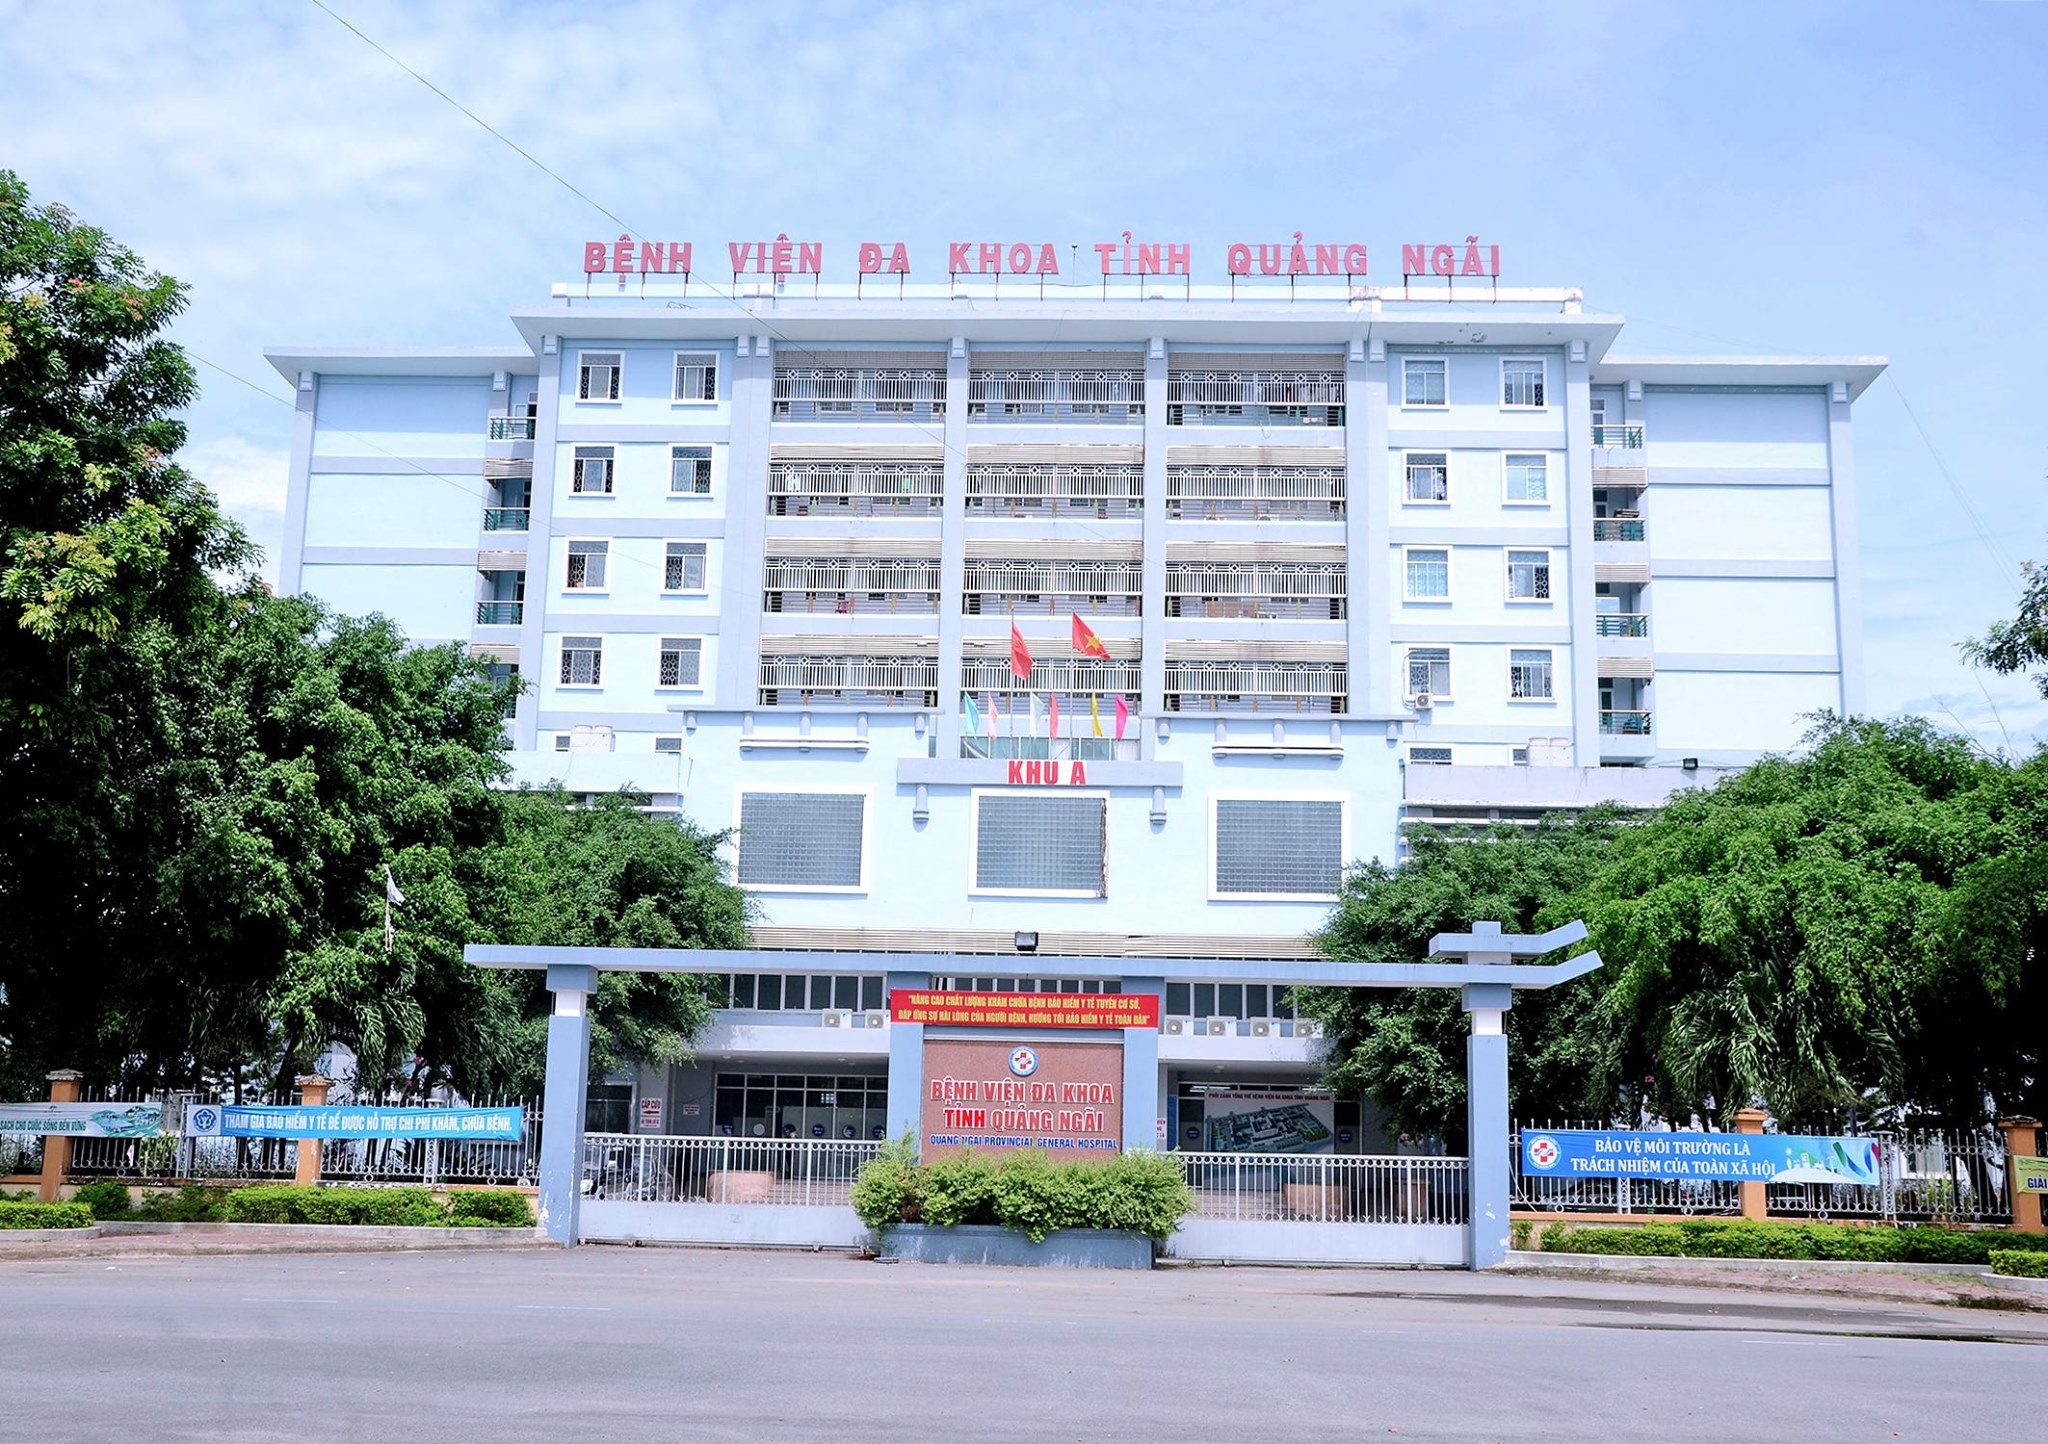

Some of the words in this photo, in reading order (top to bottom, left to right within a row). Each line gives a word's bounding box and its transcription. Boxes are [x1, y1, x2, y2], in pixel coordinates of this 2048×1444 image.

[584, 233, 692, 283] BỆNH
[729, 233, 821, 283] VIỆN
[859, 243, 911, 274] ĐA
[949, 243, 1059, 274] KHOA
[1094, 231, 1190, 274] TỈNH
[1228, 231, 1367, 276] QUẢNG
[1402, 235, 1499, 276] NGÃI
[1008, 760, 1059, 784] KHU
[1070, 760, 1086, 785] A
[931, 995, 944, 1006] CAO
[987, 994, 1007, 1007] KHÁM
[1029, 996, 1046, 1009] BỆNH
[1081, 998, 1086, 1009] Y
[1087, 996, 1095, 1009] TẾ
[1099, 1014, 1106, 1024] Y
[1106, 1012, 1113, 1024] TẾ
[930, 1075, 978, 1106] BỆNH
[983, 1077, 1026, 1106] VIỆN
[1031, 1083, 1057, 1103] ĐA
[1062, 1083, 1114, 1104] KHOA
[225, 1114, 249, 1129] THAM
[250, 1114, 265, 1129] GIA
[266, 1111, 283, 1129] BẢO
[285, 1110, 307, 1130] HIỂM
[309, 1115, 317, 1130] Y
[317, 1111, 328, 1130] TẾ
[328, 1110, 341, 1131] ĐỂ
[341, 1115, 365, 1134] ĐƯỢC
[366, 1111, 380, 1131] HỖ
[381, 1115, 398, 1134] TRỢ
[399, 1116, 413, 1131] CHI
[415, 1114, 431, 1131] PHÍ
[432, 1114, 460, 1132] KHÁM,
[487, 1114, 512, 1134] BỆNH.
[943, 1102, 986, 1128] TỈNH
[991, 1103, 1053, 1132] QUẢNG
[1059, 1107, 1103, 1132] NGÃI
[930, 1134, 959, 1146] QUANG
[1037, 1137, 1075, 1149] GENERAL
[1078, 1138, 1118, 1149] HOSPITAL
[1595, 1136, 1622, 1153] BẢO
[1624, 1137, 1642, 1156] VỆ
[1645, 1138, 1670, 1154] MÔI
[1672, 1139, 1731, 1155] TRƯỜNG
[1734, 1140, 1751, 1156] LÀ
[1570, 1155, 1615, 1172] TRÁCH
[1618, 1157, 1661, 1175] NHIỆM
[1664, 1157, 1689, 1174] CỦA
[1692, 1158, 1728, 1174] TOÀN
[1731, 1159, 1749, 1175] XÃ
[1752, 1159, 1776, 1178] HỘI
